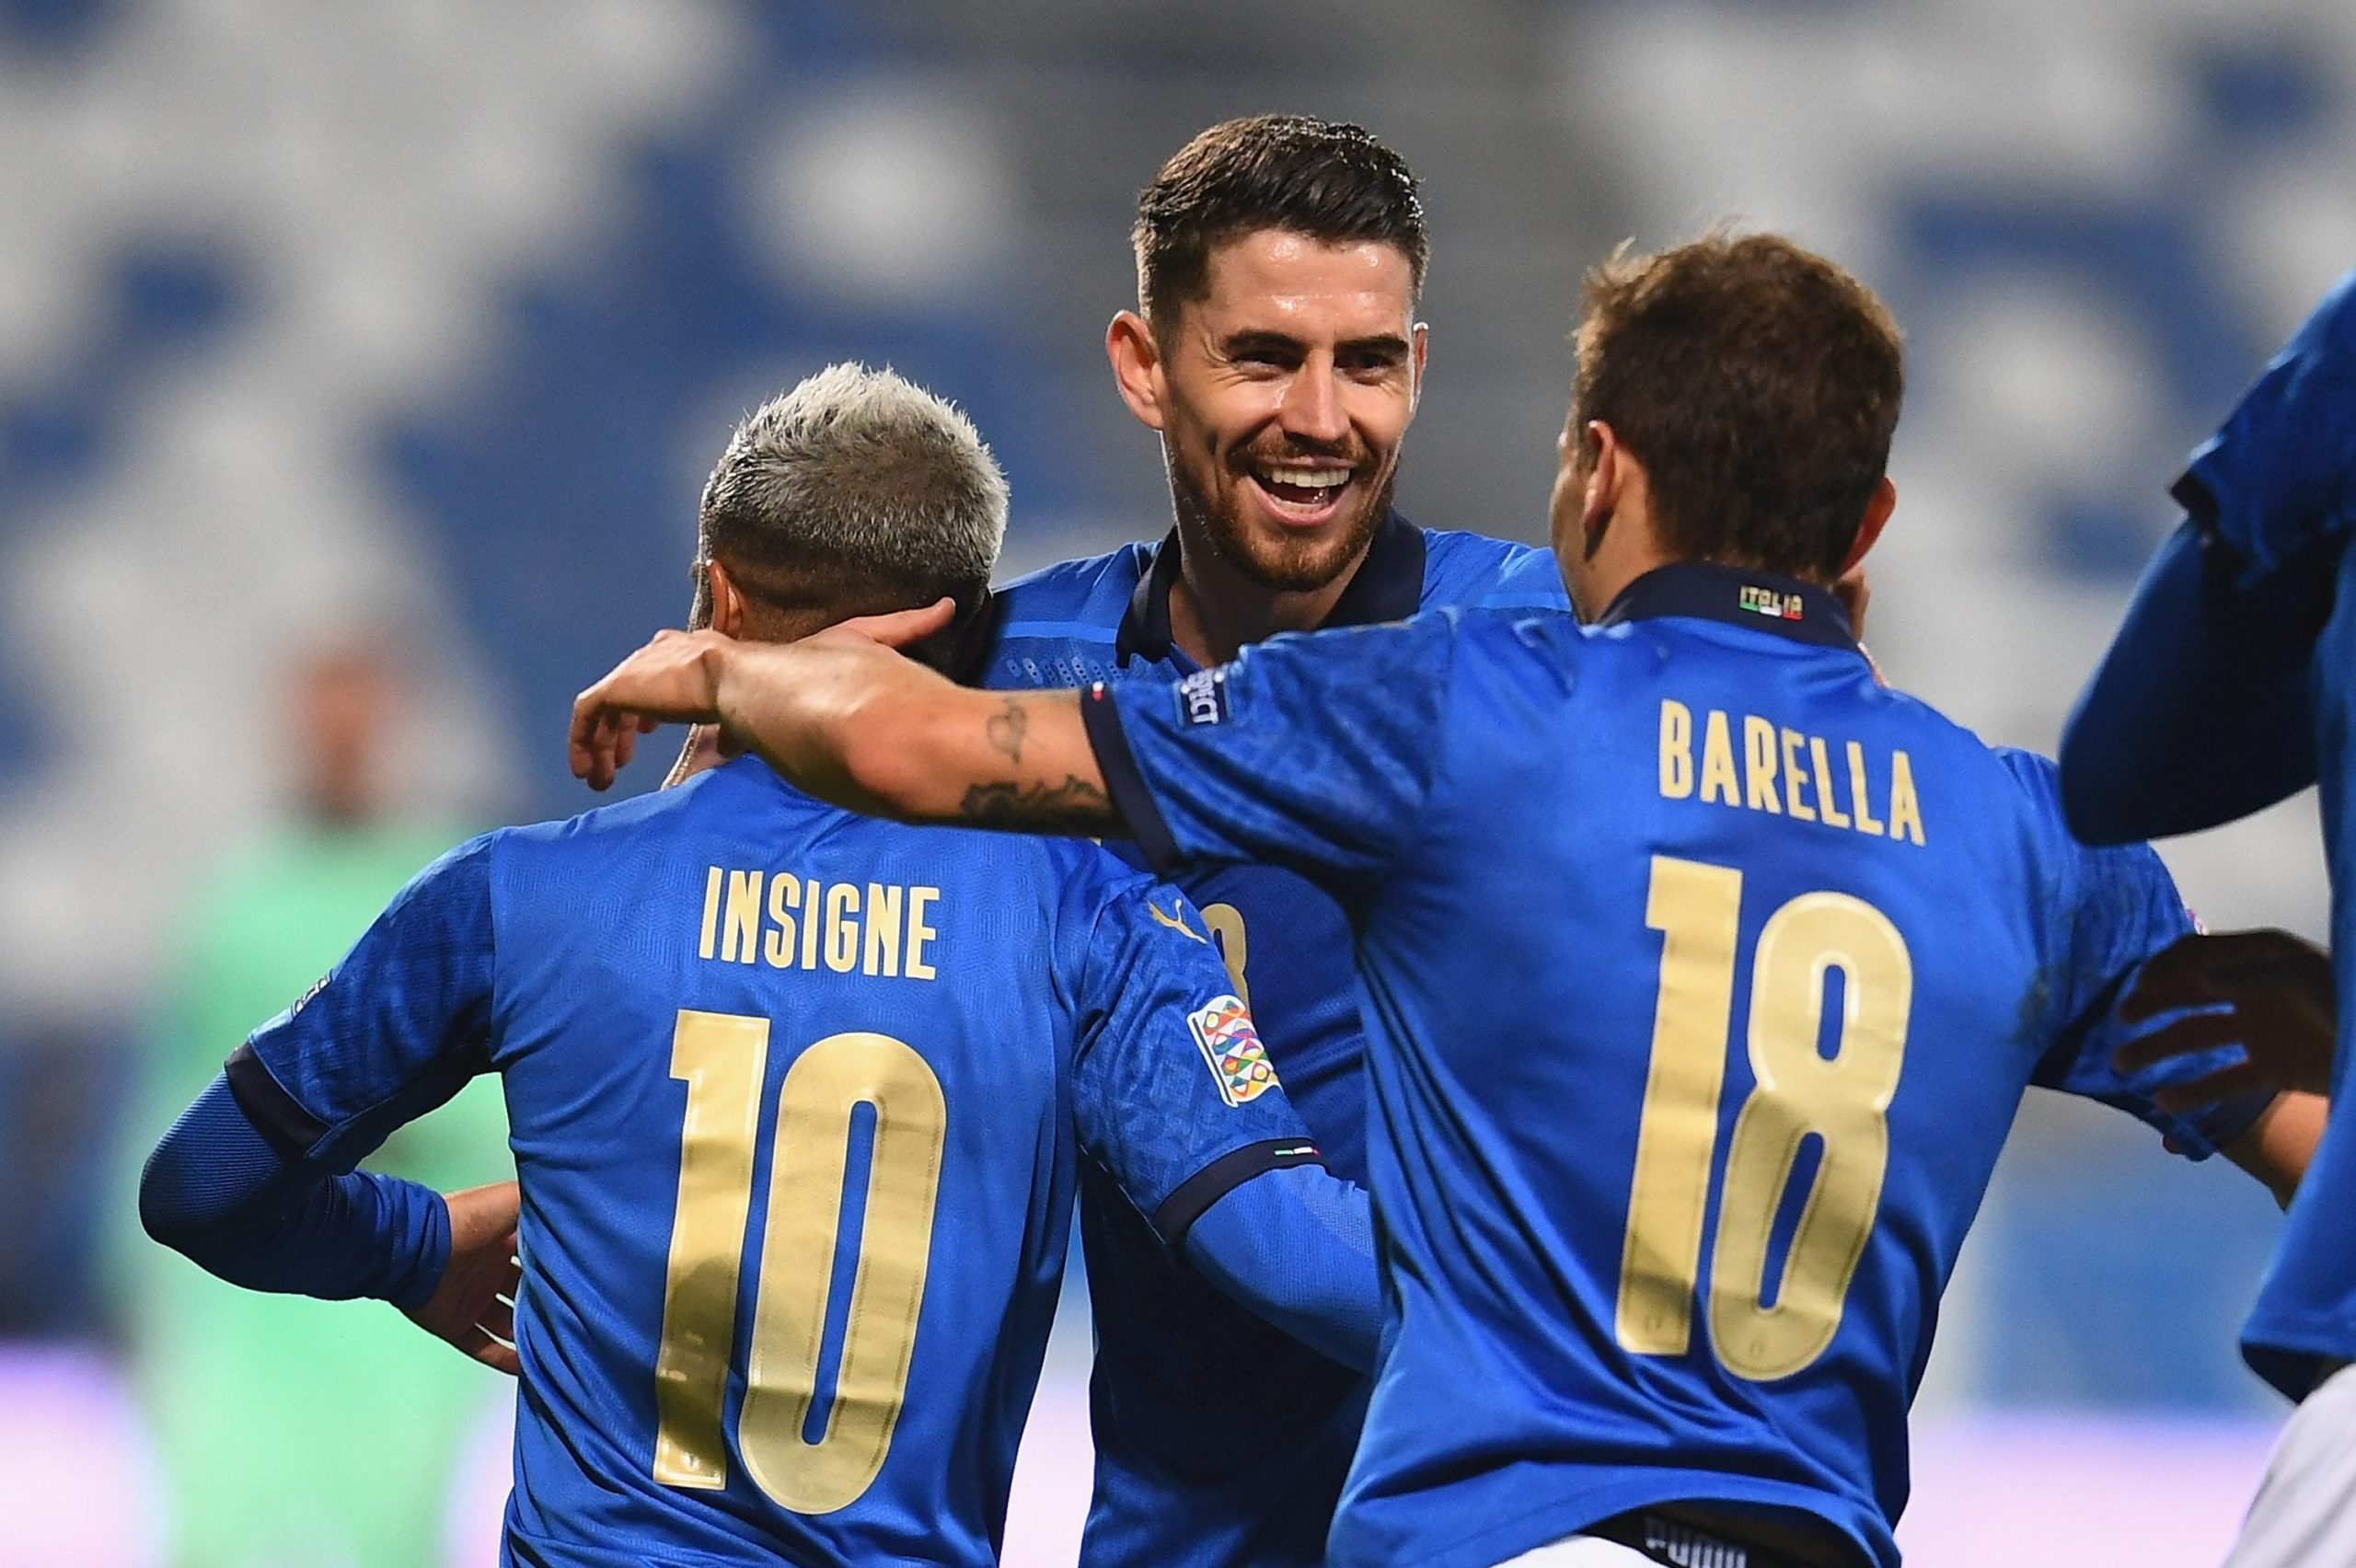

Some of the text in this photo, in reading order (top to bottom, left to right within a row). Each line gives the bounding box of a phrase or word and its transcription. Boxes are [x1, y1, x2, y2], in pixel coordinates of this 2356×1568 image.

[1738, 584, 1804, 621] ITALIA
[1658, 698, 1926, 847] BARELLA
[699, 865, 941, 981] INSIGNE
[1614, 855, 1913, 1382] 18
[653, 1009, 947, 1516] 10
